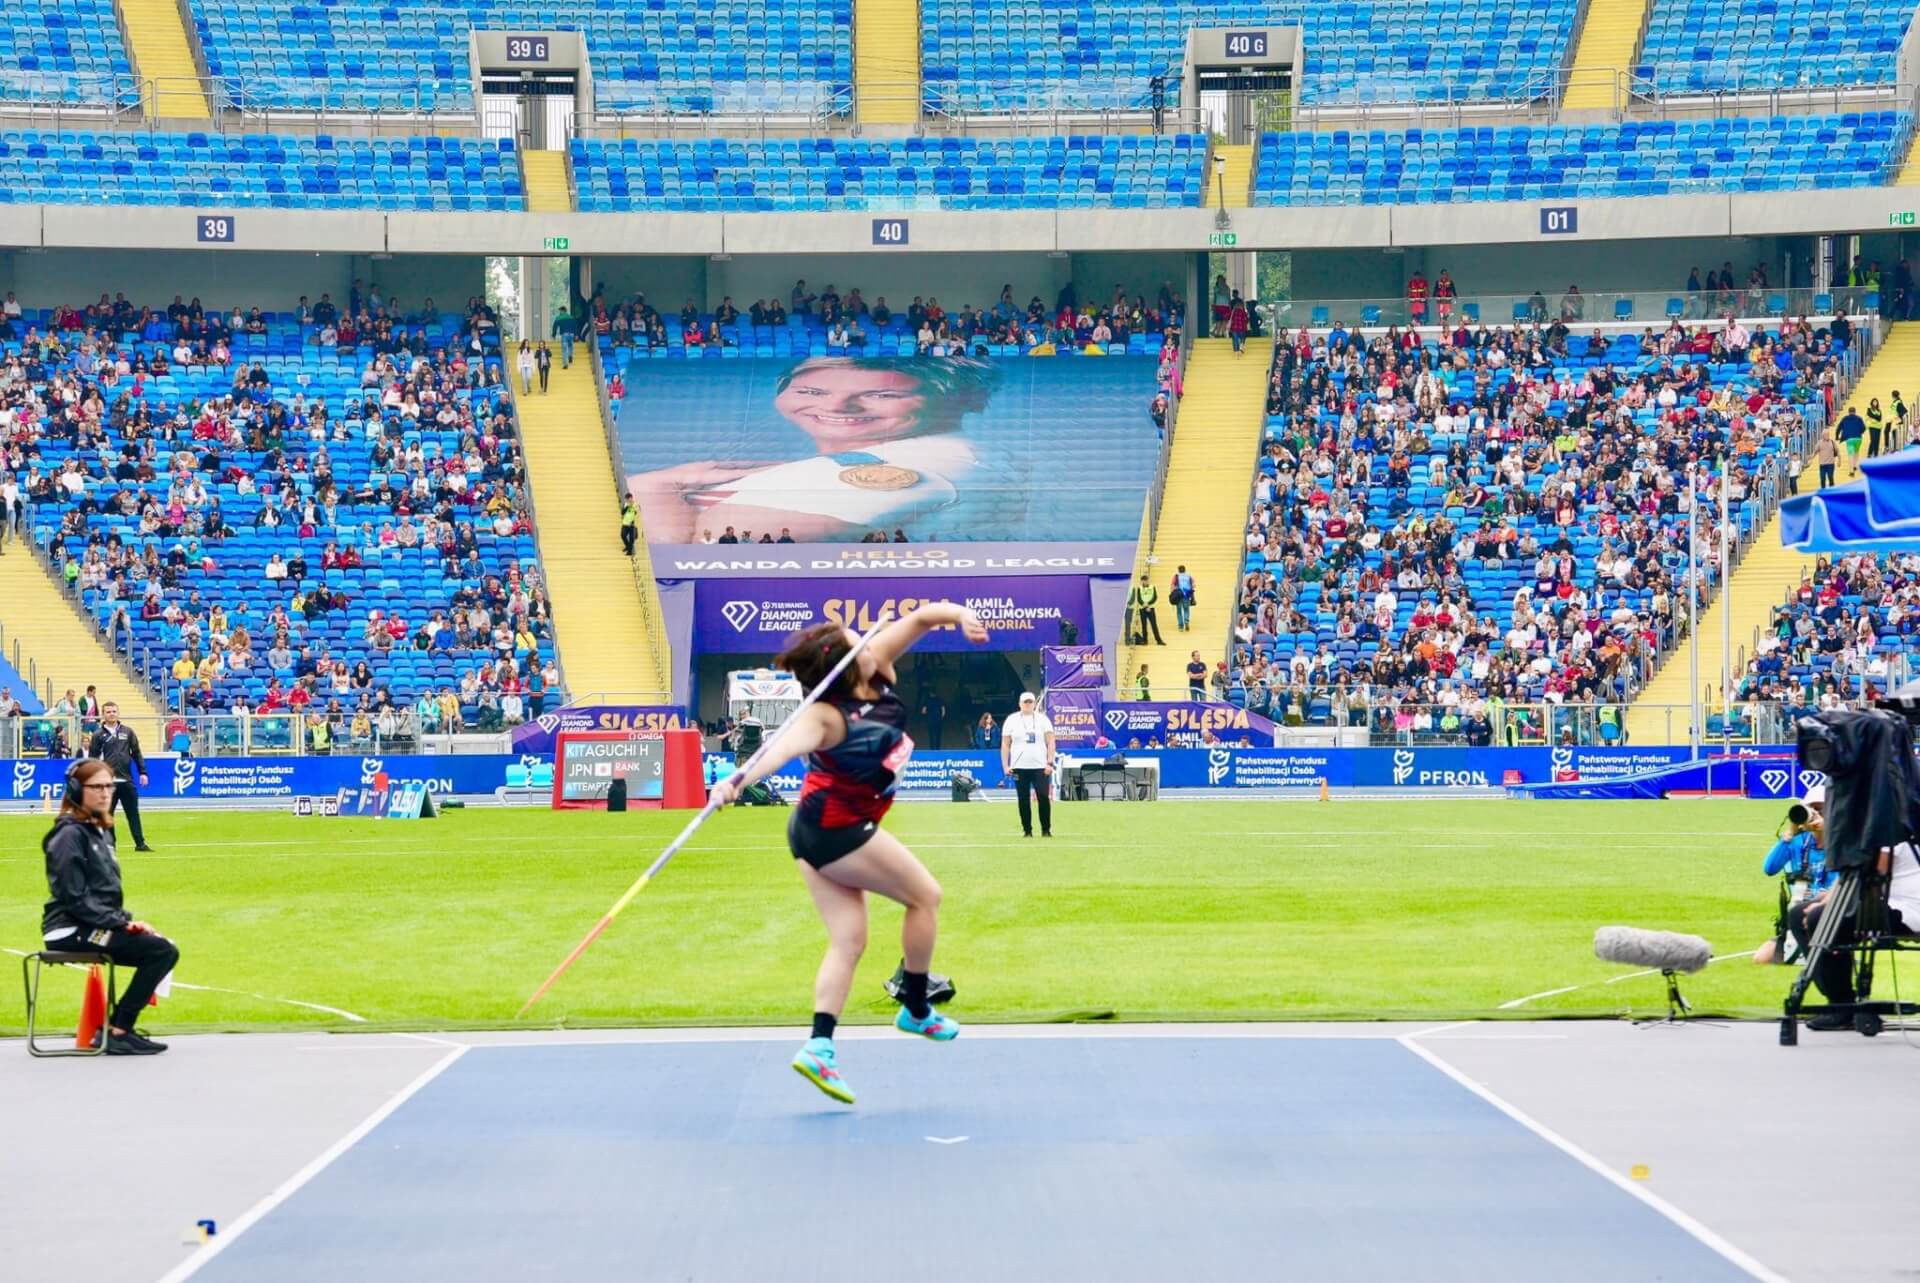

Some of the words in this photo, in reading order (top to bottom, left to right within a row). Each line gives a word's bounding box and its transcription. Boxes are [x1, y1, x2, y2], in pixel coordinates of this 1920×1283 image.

[510, 40, 531, 57] 39
[535, 43, 545, 57] G
[1229, 36, 1250, 53] 40
[1254, 38, 1264, 53] G
[1547, 210, 1568, 230] 01
[205, 219, 228, 238] 39
[880, 222, 902, 241] 40
[841, 550, 949, 560] HELLO
[674, 560, 801, 570] WANDA
[811, 559, 976, 569] DIAMOND
[986, 557, 1116, 568] LEAGUE
[965, 598, 1014, 609] KAMILA
[760, 610, 814, 621] DIAMOND
[971, 607, 1062, 619] KOLIMOWSKA
[758, 621, 802, 631] LEAGUE
[561, 719, 594, 727] DIAMOND
[599, 713, 681, 730] SILESIA
[1054, 713, 1096, 726] SILESIA
[1166, 708, 1250, 730] SILESIA
[1128, 722, 1155, 730] LEAGUE
[566, 744, 637, 757] KITAGUCHI
[639, 744, 649, 757] H
[946, 759, 985, 768] Fundusz
[1235, 756, 1288, 766] Państwowy
[1289, 757, 1328, 765] Fundusz
[1578, 754, 1631, 765] Państwowy
[1632, 755, 1671, 763] Fundusz
[201, 765, 255, 776] Państwowy
[256, 766, 295, 774] Fundusz
[568, 763, 593, 777] JPN
[614, 762, 640, 772] RANK
[653, 761, 662, 776] 3
[1235, 766, 1291, 776] Rehabilitacji
[1291, 766, 1316, 775] Osób
[1578, 764, 1634, 775] Rehabilitacji
[201, 776, 257, 786] Rehabilitacji
[258, 776, 282, 785] Osób
[1420, 770, 1486, 785] PFRON
[201, 786, 292, 796] Niepełnosprawnych
[326, 802, 337, 814] 20
